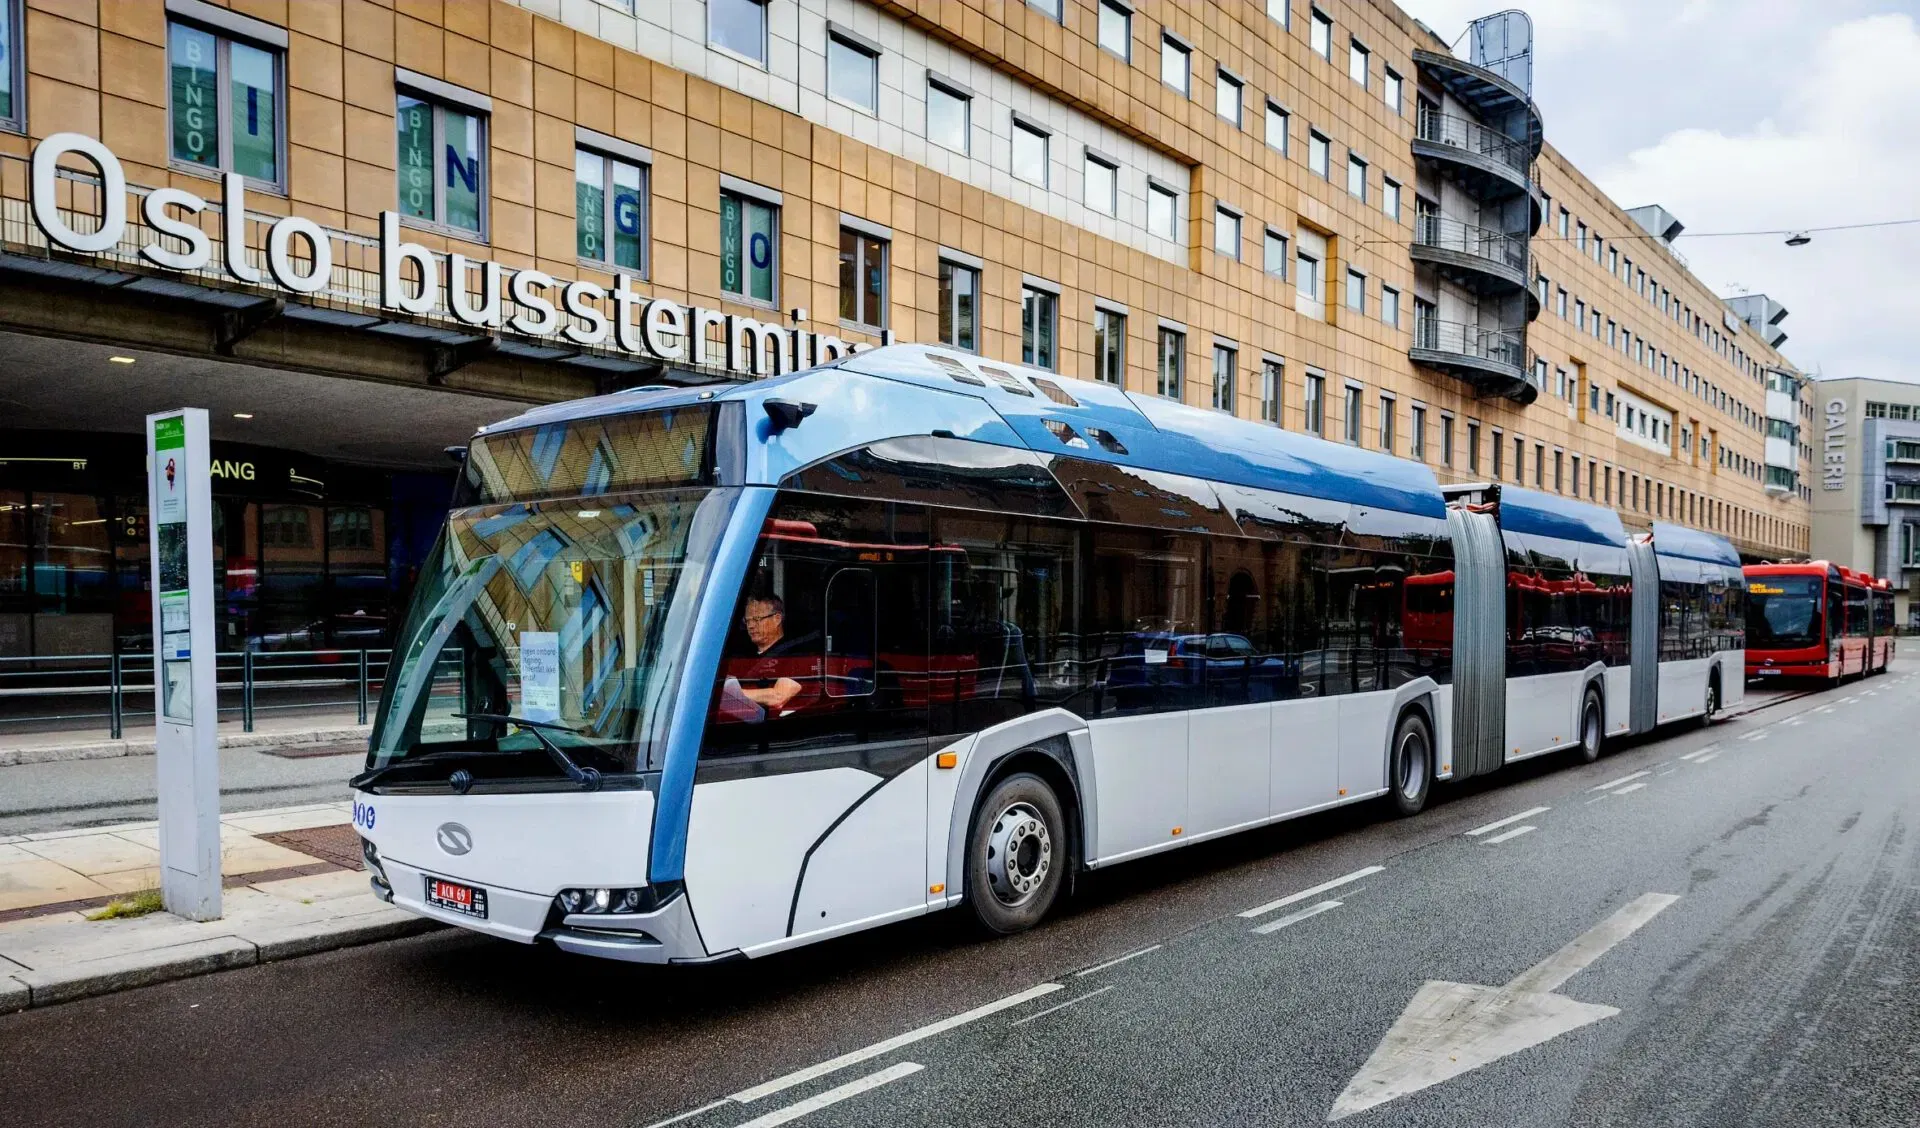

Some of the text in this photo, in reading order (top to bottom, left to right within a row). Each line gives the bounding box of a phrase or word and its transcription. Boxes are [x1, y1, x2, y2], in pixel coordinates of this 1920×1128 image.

[186, 38, 204, 153] BINGO
[408, 109, 423, 208] BINGO
[30, 131, 895, 377] Oslo busstermin
[583, 182, 596, 251] INGO
[726, 205, 735, 285] BINGO
[73, 461, 87, 470] BT
[1823, 396, 1847, 483] GALLERI
